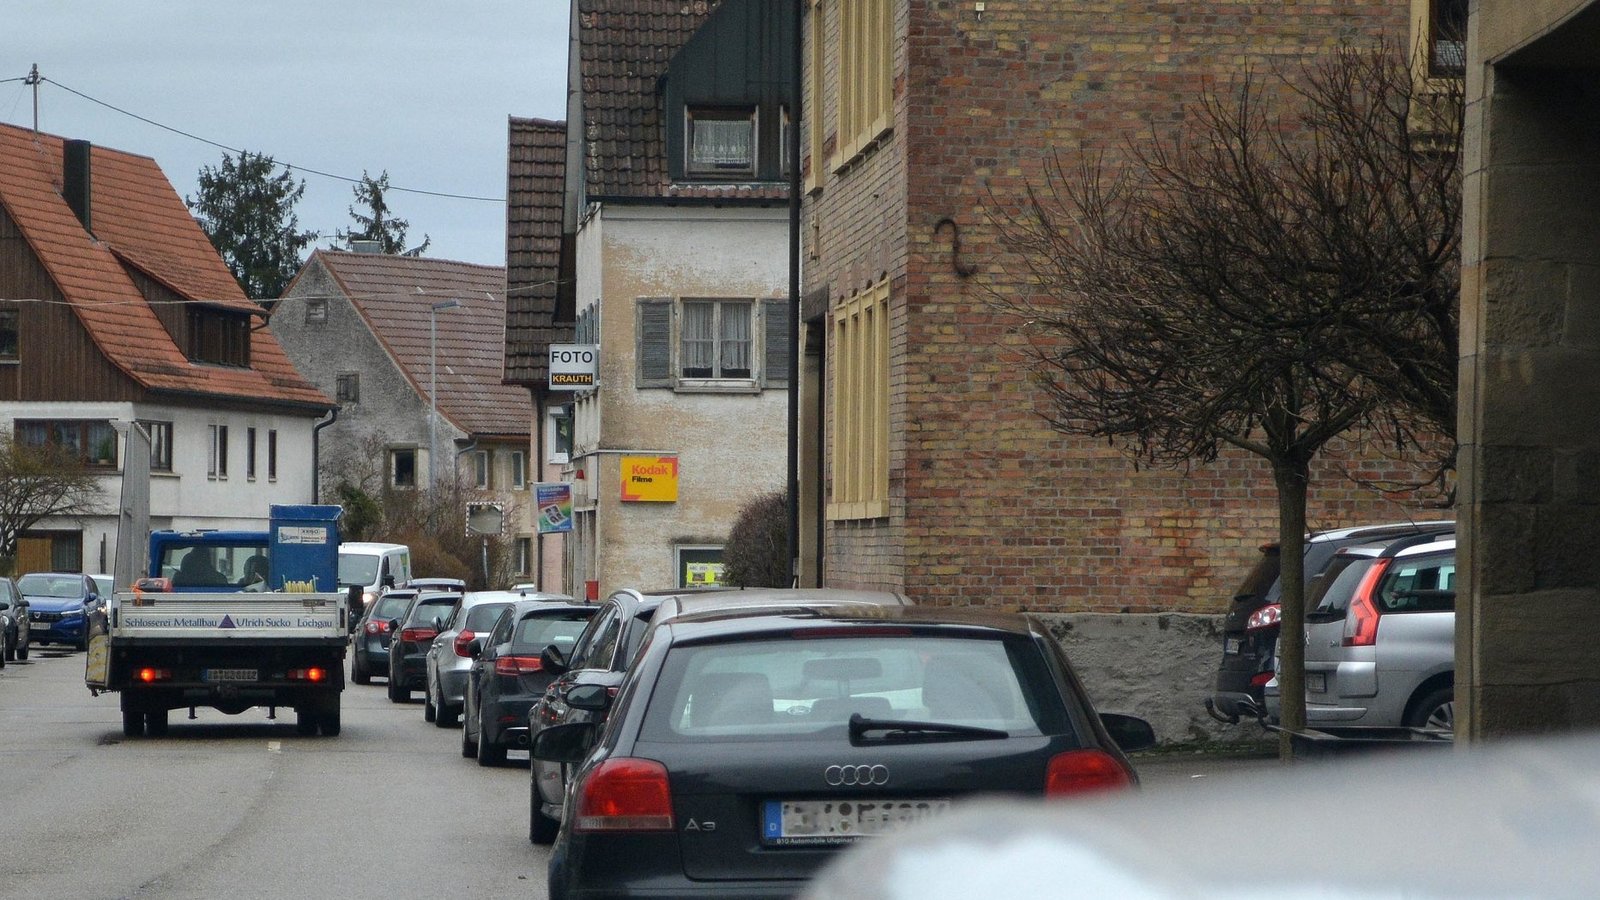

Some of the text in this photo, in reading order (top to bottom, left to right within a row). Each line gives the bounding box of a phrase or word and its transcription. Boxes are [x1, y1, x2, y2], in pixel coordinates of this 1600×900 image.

[551, 351, 593, 363] FOTO
[552, 375, 592, 383] KRAUTH
[632, 464, 668, 475] Kodak
[125, 618, 171, 627] Schlosserei
[174, 618, 217, 627] Metallbau
[236, 618, 264, 627] Ulrich
[266, 618, 291, 627] Sucko
[685, 818, 716, 831] A3
